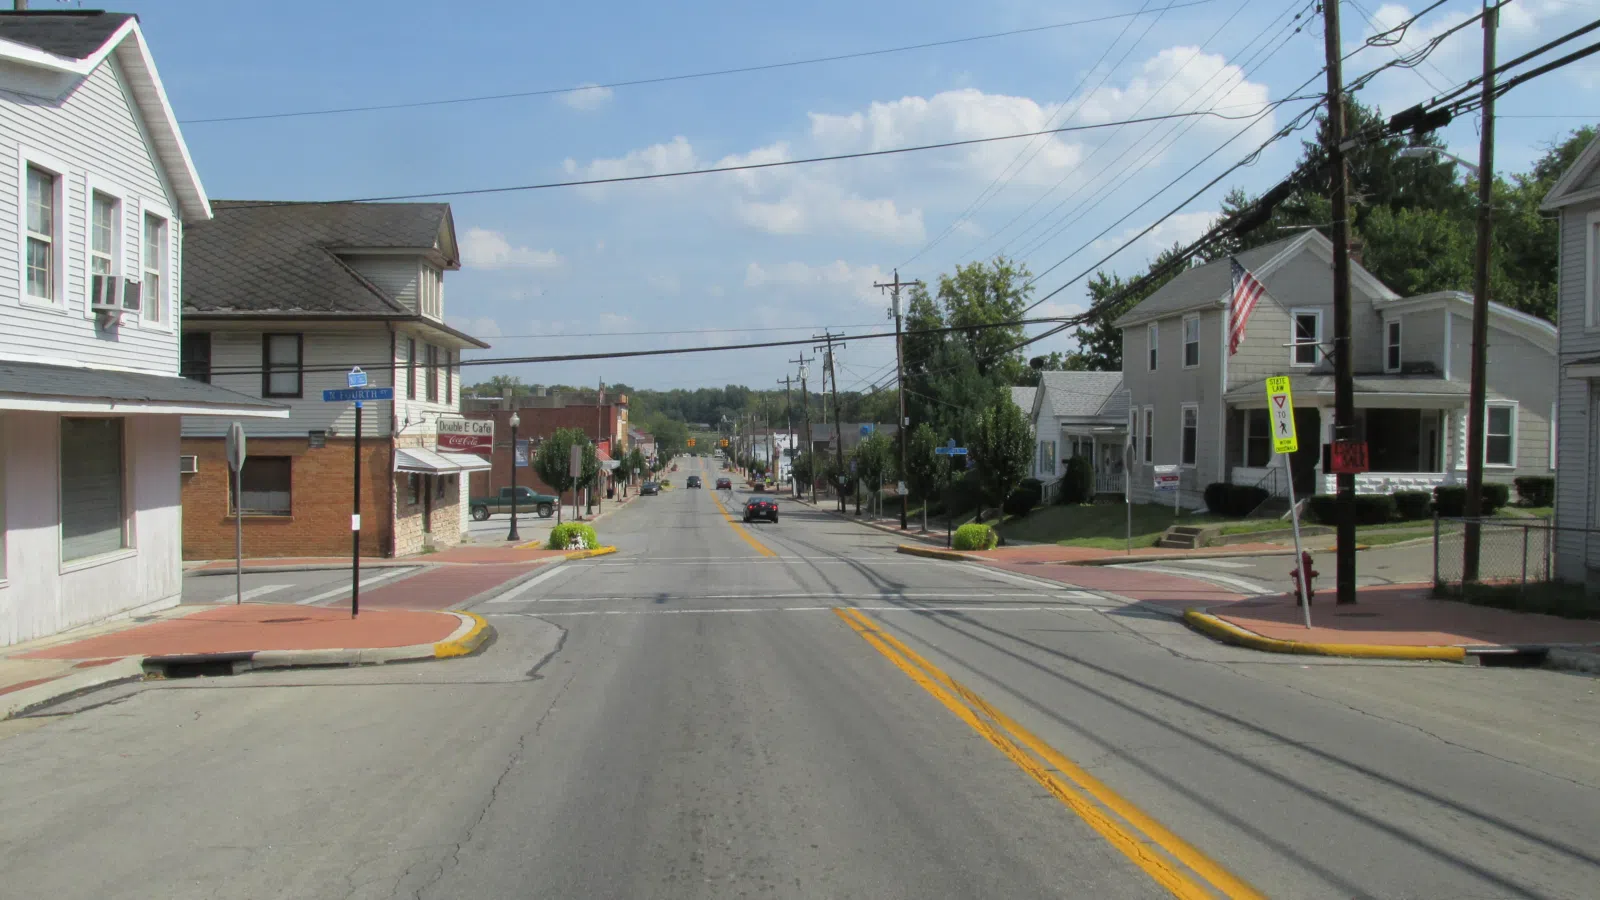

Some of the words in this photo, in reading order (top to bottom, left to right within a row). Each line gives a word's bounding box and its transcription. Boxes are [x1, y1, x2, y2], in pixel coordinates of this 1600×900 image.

[340, 390, 377, 400] FOURTH
[1278, 411, 1286, 419] TO
[439, 421, 463, 432] Double
[464, 422, 470, 432] E
[472, 422, 491, 433] Cafe
